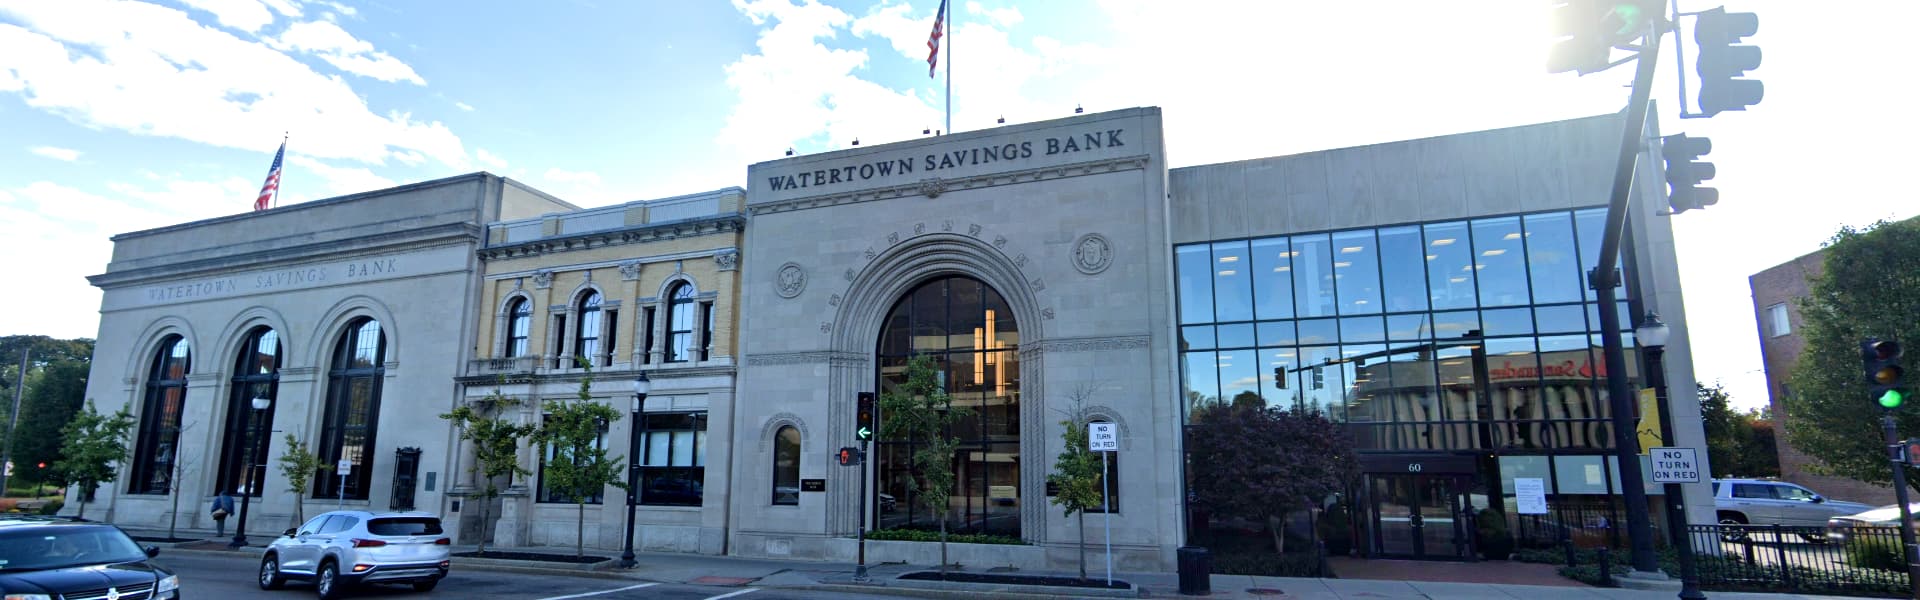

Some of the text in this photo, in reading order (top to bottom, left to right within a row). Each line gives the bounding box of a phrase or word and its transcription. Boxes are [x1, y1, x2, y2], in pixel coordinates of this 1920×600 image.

[767, 129, 1125, 191] WATERTOWN SAVINGS BANK
[148, 258, 397, 301] WATERTOWN SAVINGS BANK
[1408, 463, 1421, 472] 60
[1654, 471, 1697, 479] ON RED
